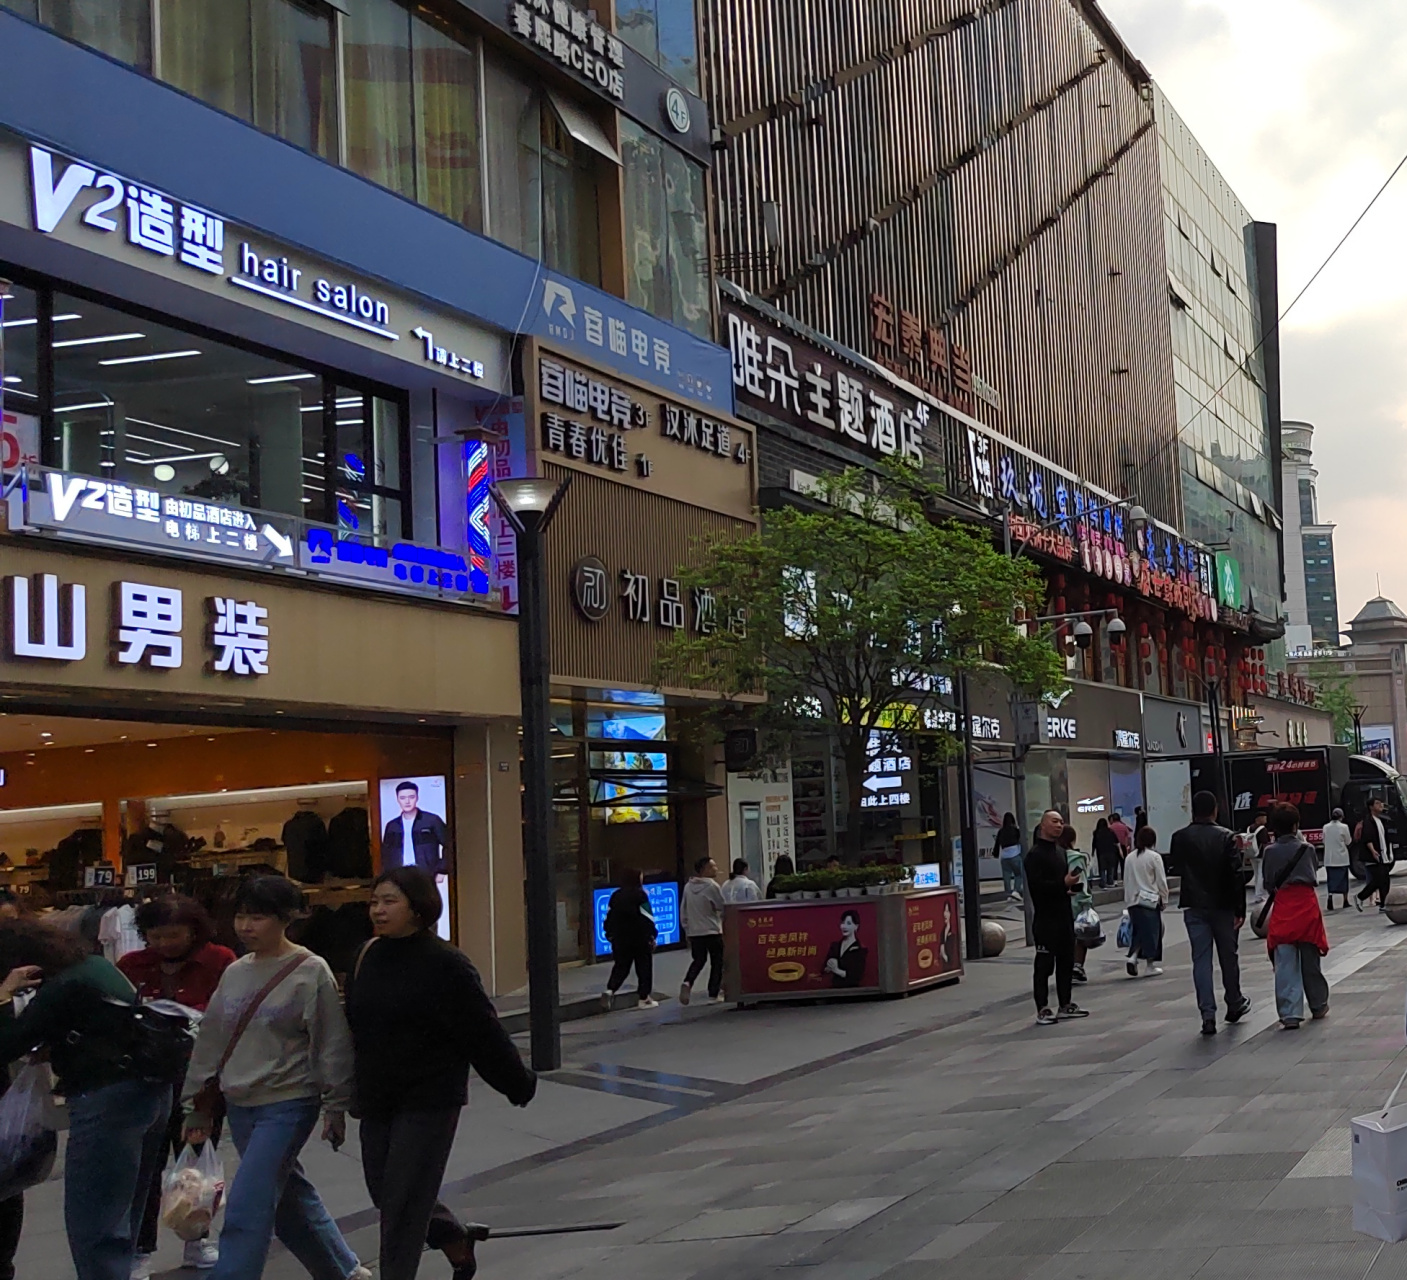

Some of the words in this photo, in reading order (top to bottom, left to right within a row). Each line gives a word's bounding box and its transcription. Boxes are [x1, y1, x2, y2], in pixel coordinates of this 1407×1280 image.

[28, 145, 225, 276] V2造型
[240, 242, 302, 293] hair
[315, 276, 391, 325] salon
[870, 292, 973, 393] 宏泰典当
[433, 346, 484, 379] 请上二楼
[727, 311, 925, 470] 唯朵主题酒店
[915, 400, 931, 427] 4F
[635, 402, 653, 428] 3F
[546, 411, 629, 471] 青春优佳
[639, 453, 655, 478] 1F
[665, 404, 732, 458] 汉沐足道
[736, 442, 752, 464] 4F
[977, 435, 989, 455] 3F
[45, 471, 161, 524] V2造型
[165, 497, 258, 531] 由初品酒店进入
[165, 519, 258, 552] 电梯上二楼
[12, 572, 270, 676] 山男装
[1046, 717, 1077, 740] ERKE
[1077, 803, 1105, 813] ERKE
[97, 870, 113, 884] 79
[138, 868, 156, 881] 199
